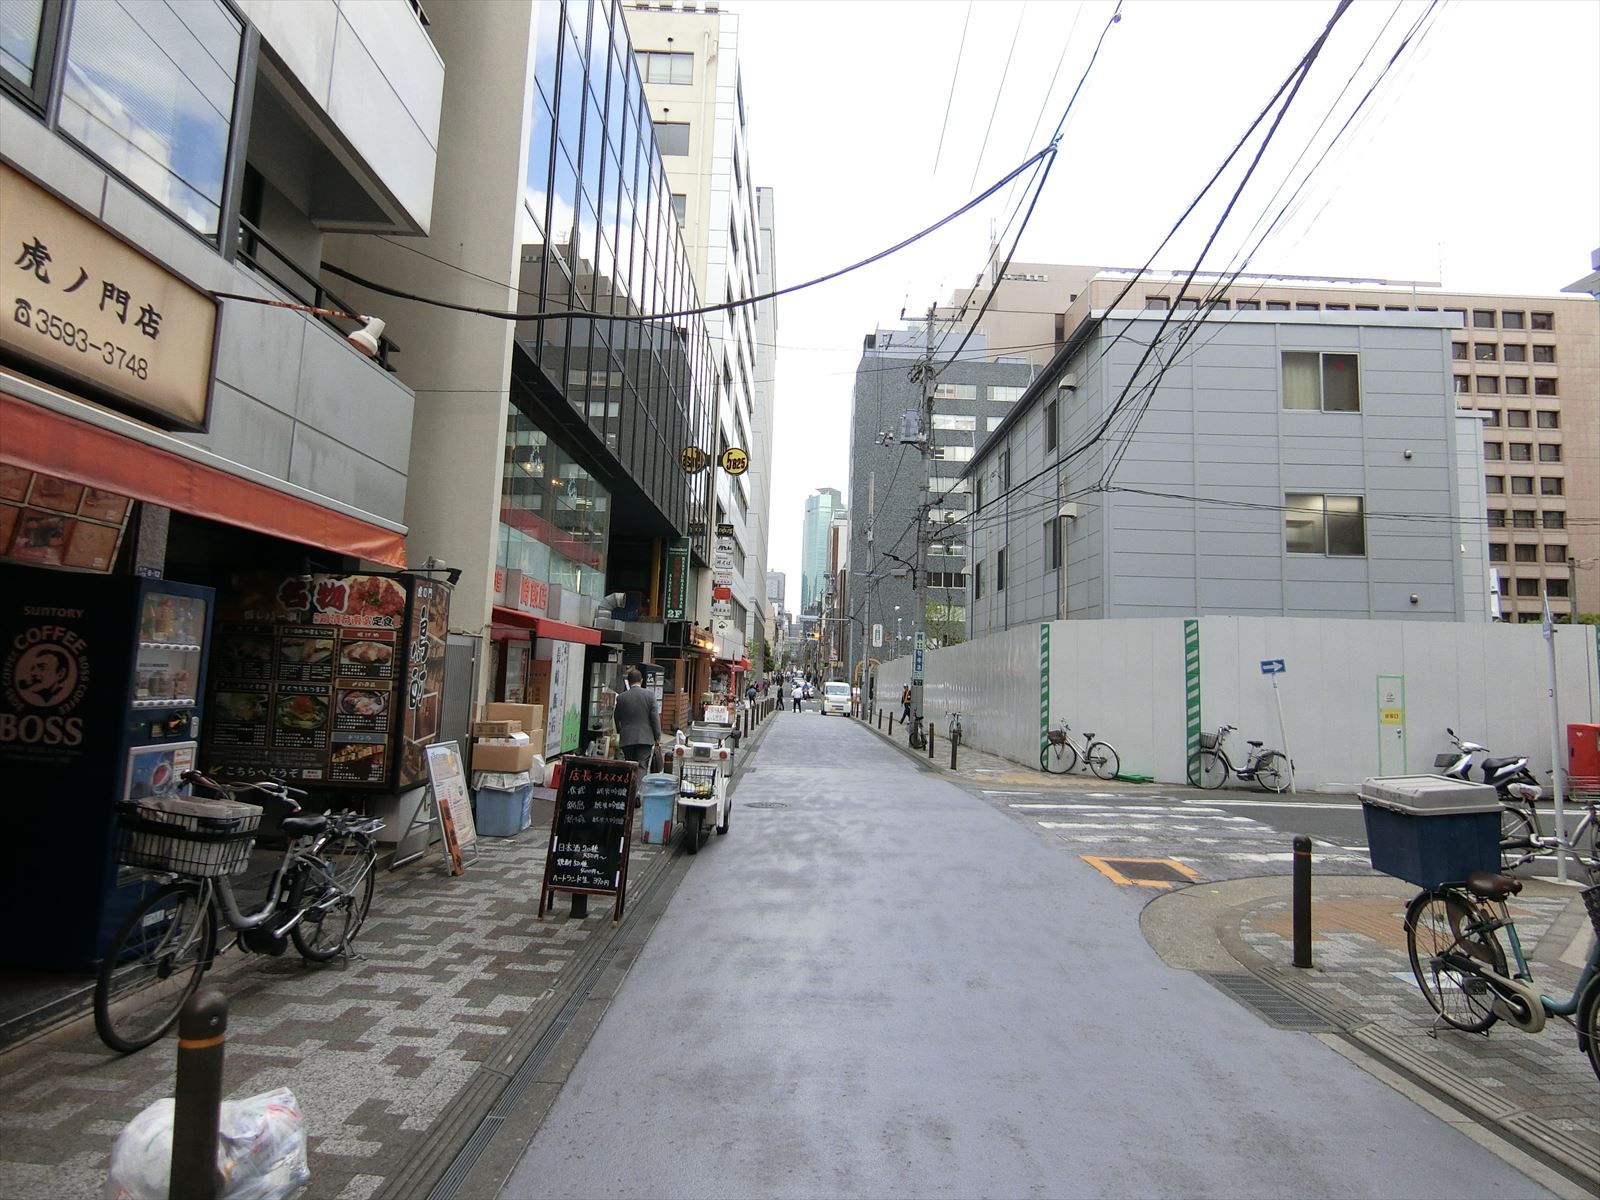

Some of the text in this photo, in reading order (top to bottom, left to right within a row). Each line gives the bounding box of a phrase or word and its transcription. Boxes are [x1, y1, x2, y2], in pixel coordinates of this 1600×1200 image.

[14, 237, 163, 340] 虎ノ門店
[36, 308, 149, 381] 3593-3748
[23, 606, 84, 618] SUNTORY
[667, 609, 683, 618] 2F
[14, 624, 89, 656] COFFEE
[0, 712, 84, 746] BOSS
[225, 766, 299, 778] こちらへどうぞ
[568, 768, 592, 783] 店長
[558, 842, 581, 852] 日本酒
